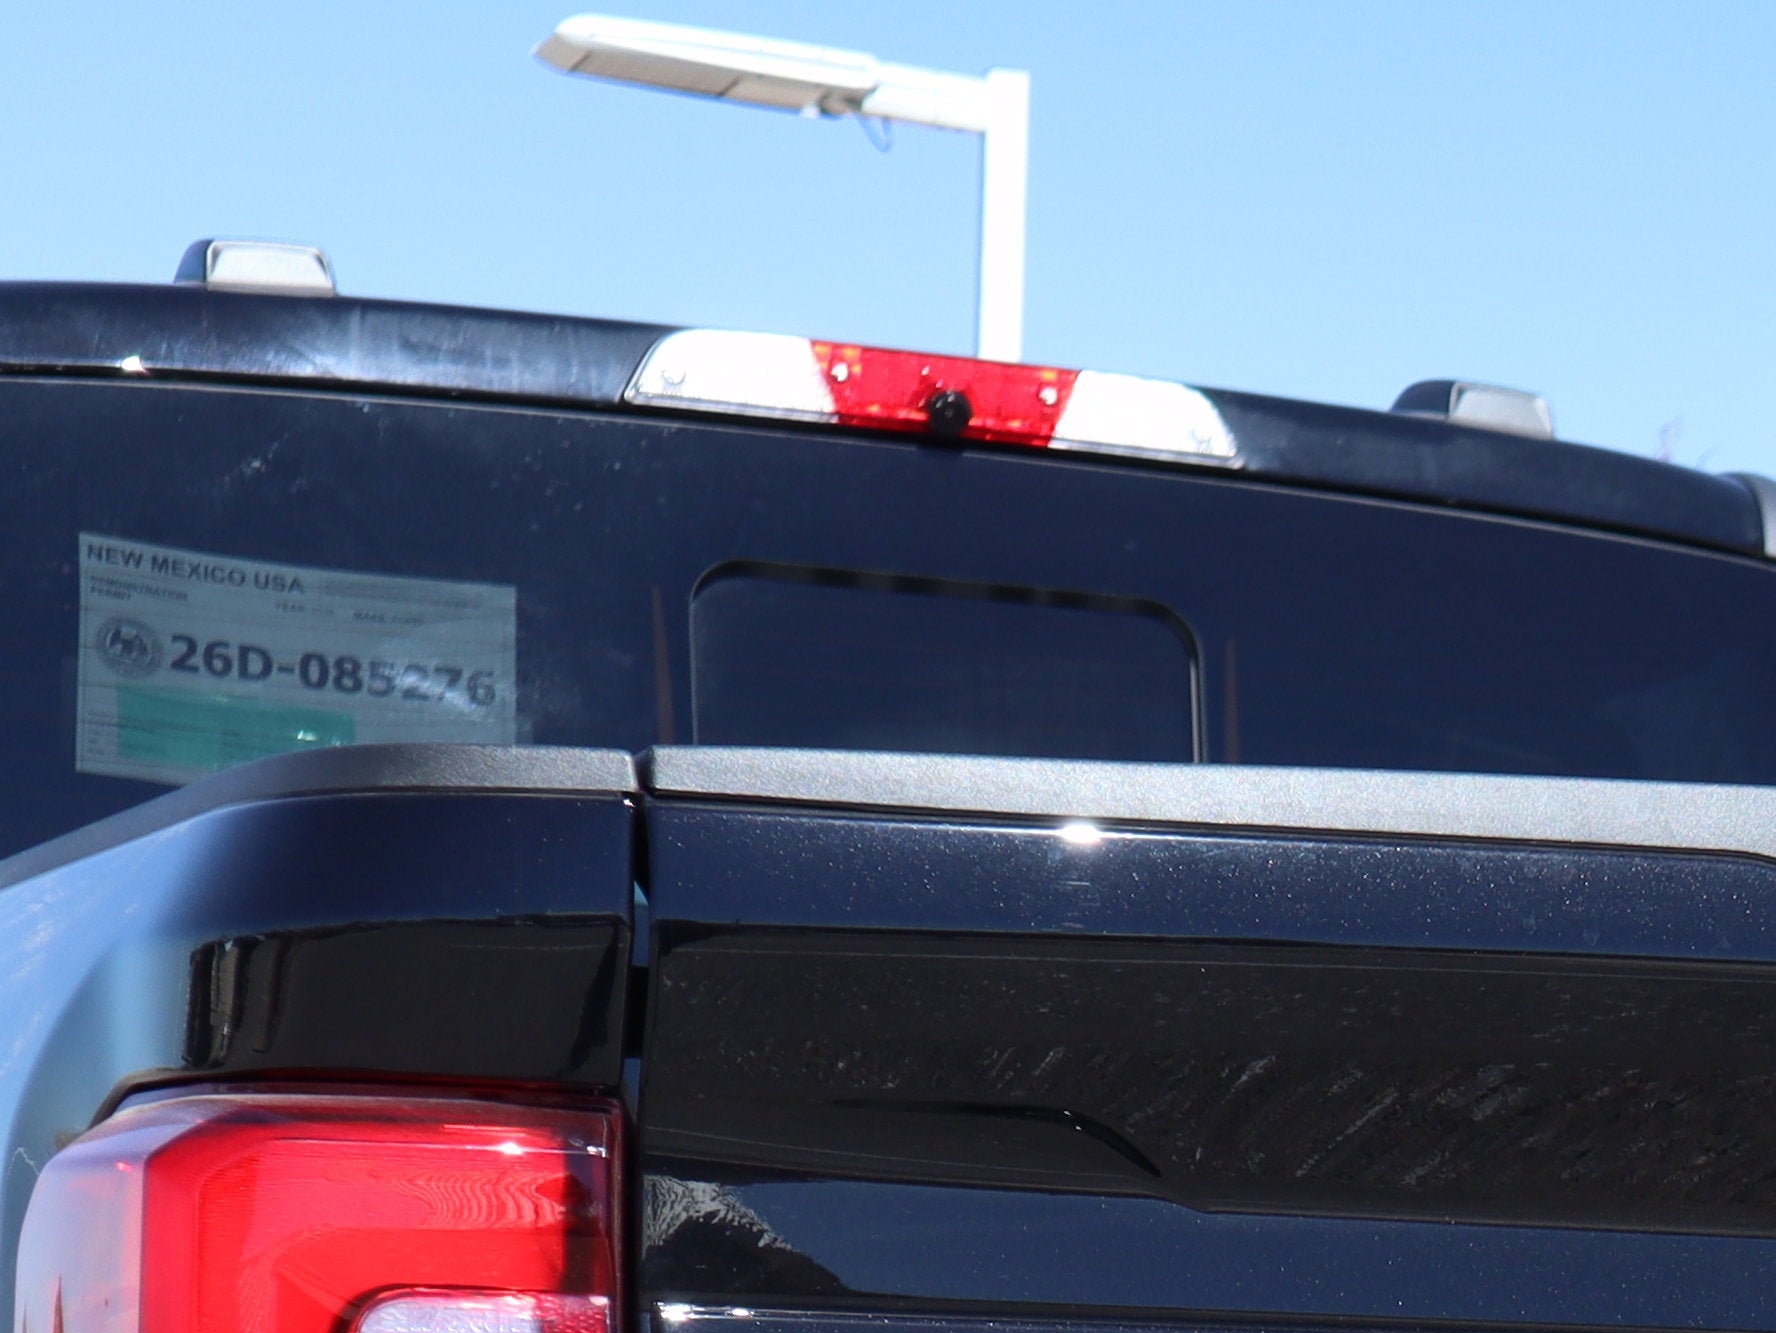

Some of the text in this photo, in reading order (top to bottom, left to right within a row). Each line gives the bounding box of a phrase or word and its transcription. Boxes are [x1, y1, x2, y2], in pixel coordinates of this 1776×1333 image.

[86, 543, 144, 569] NEW
[151, 554, 246, 587] MEXICO
[253, 570, 305, 594] USA
[169, 633, 497, 707] 26D-085276
